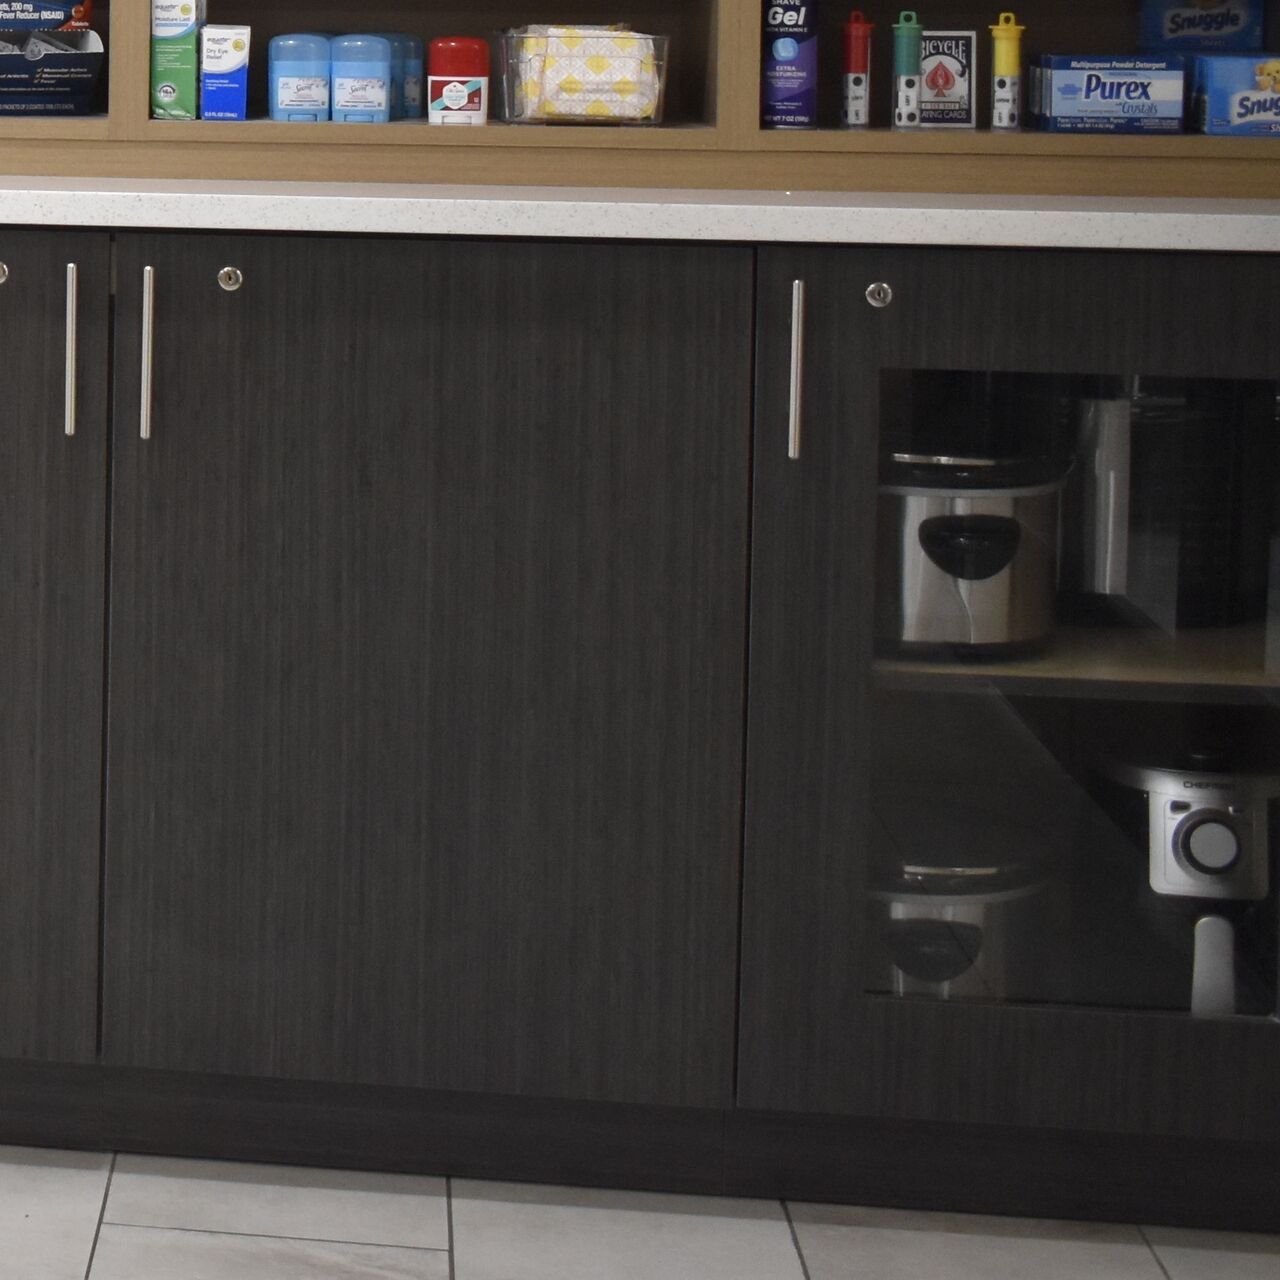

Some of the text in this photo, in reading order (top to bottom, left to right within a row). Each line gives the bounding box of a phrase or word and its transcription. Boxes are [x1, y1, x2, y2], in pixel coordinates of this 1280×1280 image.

[11, 2, 22, 10] 200
[23, 4, 33, 12] mg
[16, 11, 40, 19] Reducer
[768, 6, 807, 26] Gel
[1169, 8, 1240, 34] Snuggle
[1135, 61, 1166, 70] Detergent
[1084, 73, 1152, 101] Purex
[943, 111, 968, 119] CARDS
[1121, 102, 1158, 116] Crystals
